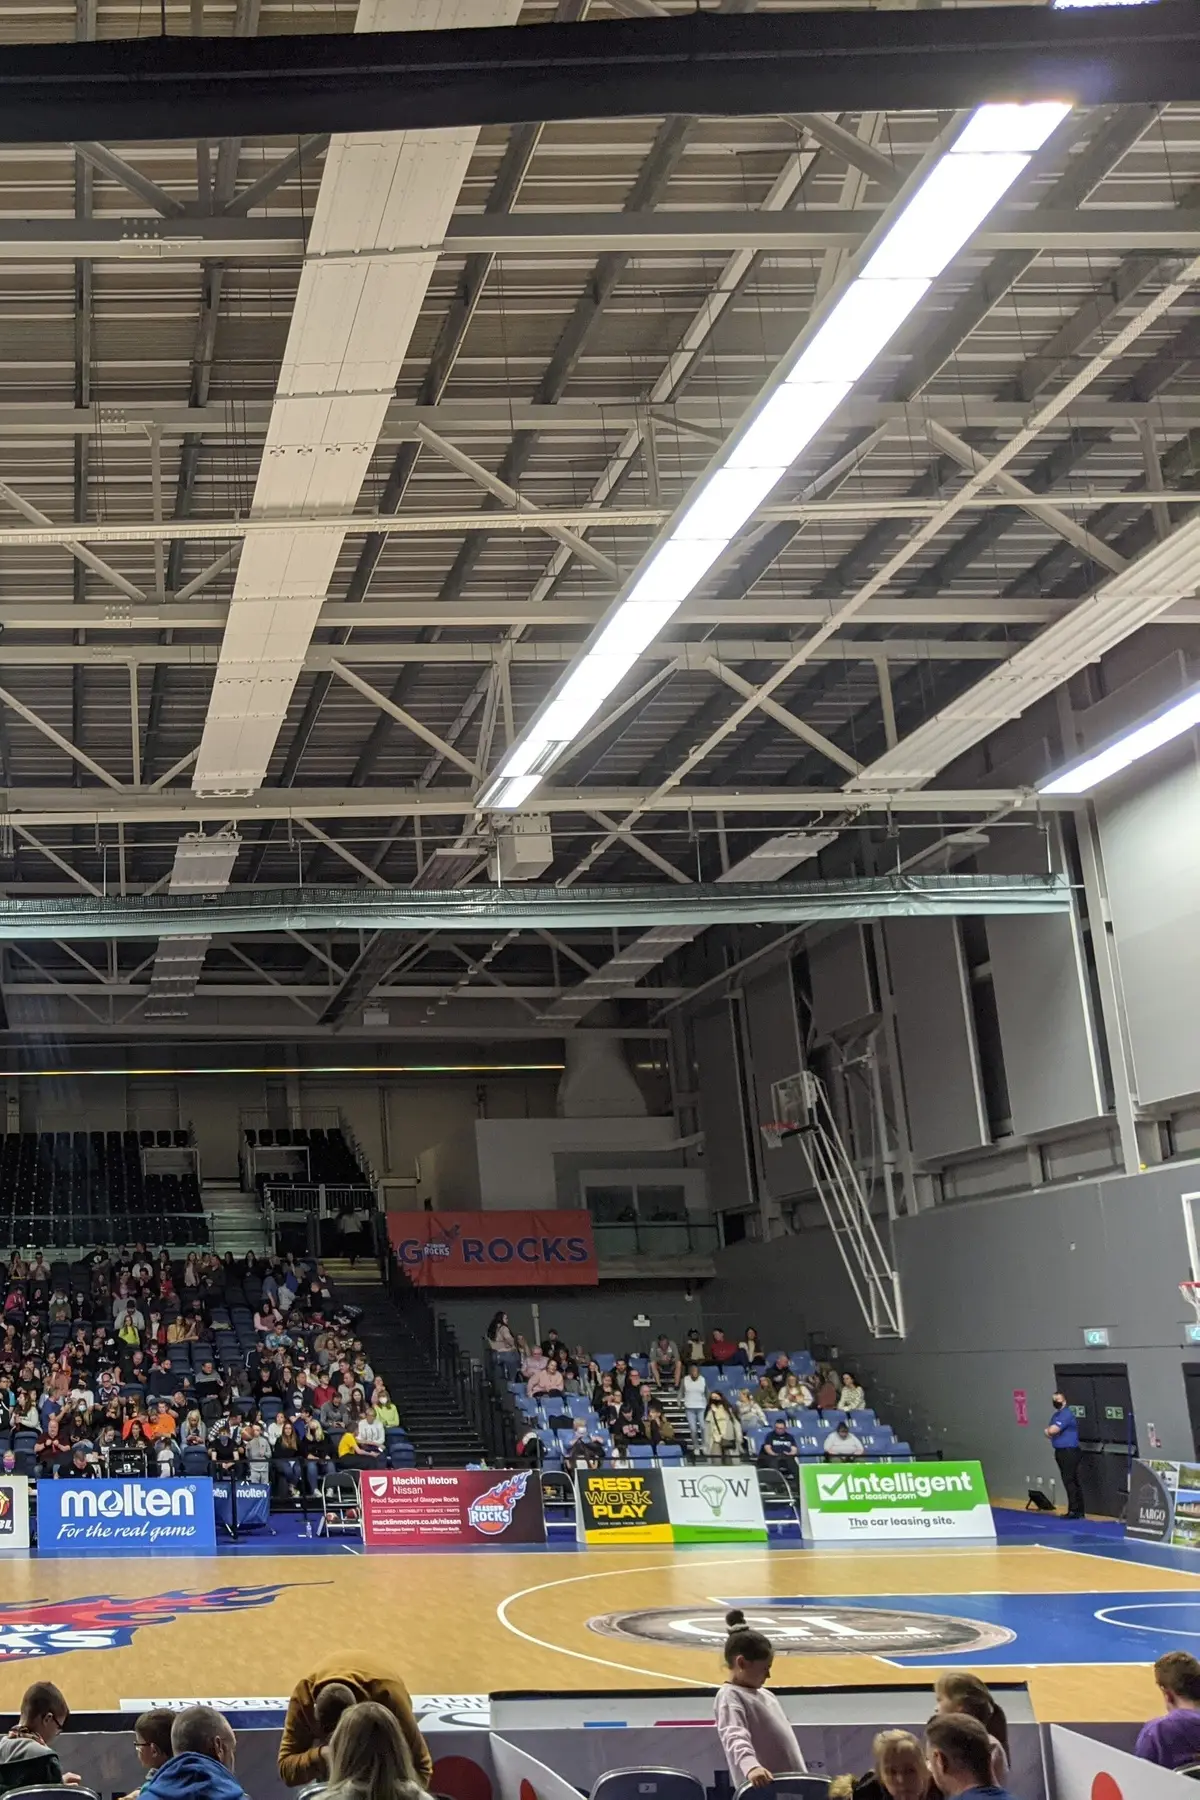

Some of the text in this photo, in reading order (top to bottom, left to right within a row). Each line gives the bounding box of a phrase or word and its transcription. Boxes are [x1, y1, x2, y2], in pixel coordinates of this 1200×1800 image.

[424, 1247, 450, 1256] ROCKS
[462, 1237, 589, 1264] ROCKS
[392, 1476, 458, 1485] Macklin Motors
[588, 1477, 644, 1491] REST
[847, 1471, 973, 1497] Intelligent
[236, 1488, 267, 1498] molten
[393, 1486, 423, 1494] Nissan
[61, 1484, 195, 1517] molten
[584, 1490, 653, 1505] WORK
[471, 1510, 509, 1522] ROCKS
[592, 1505, 647, 1518] PLAY
[1140, 1507, 1166, 1521] LARGO
[848, 1516, 956, 1528] The car leasing site.
[56, 1521, 196, 1542] For the real game
[150, 1699, 290, 1708] UNIVER
